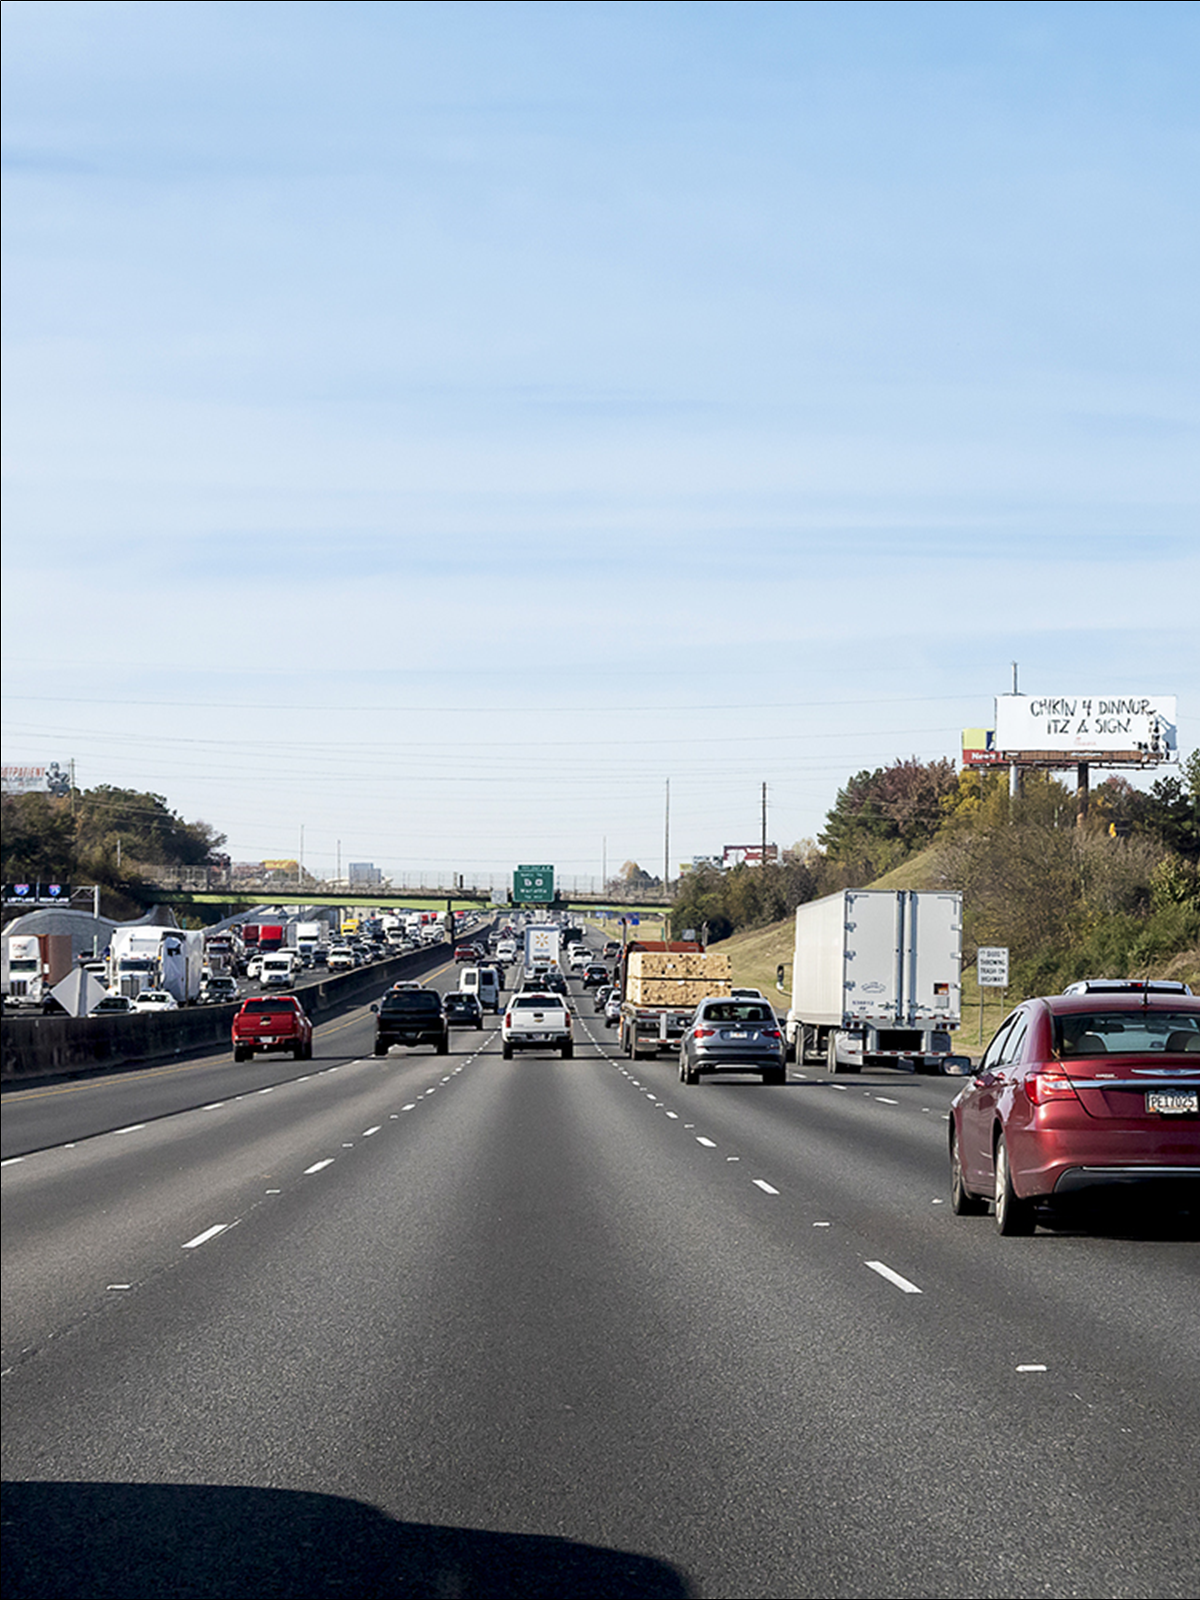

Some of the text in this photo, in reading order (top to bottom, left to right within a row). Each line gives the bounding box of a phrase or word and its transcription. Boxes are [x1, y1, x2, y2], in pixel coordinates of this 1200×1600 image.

[1030, 698, 1150, 717] CHIKIN 4 DINNUR
[1047, 719, 1071, 735] ITZ
[1076, 719, 1089, 734] A
